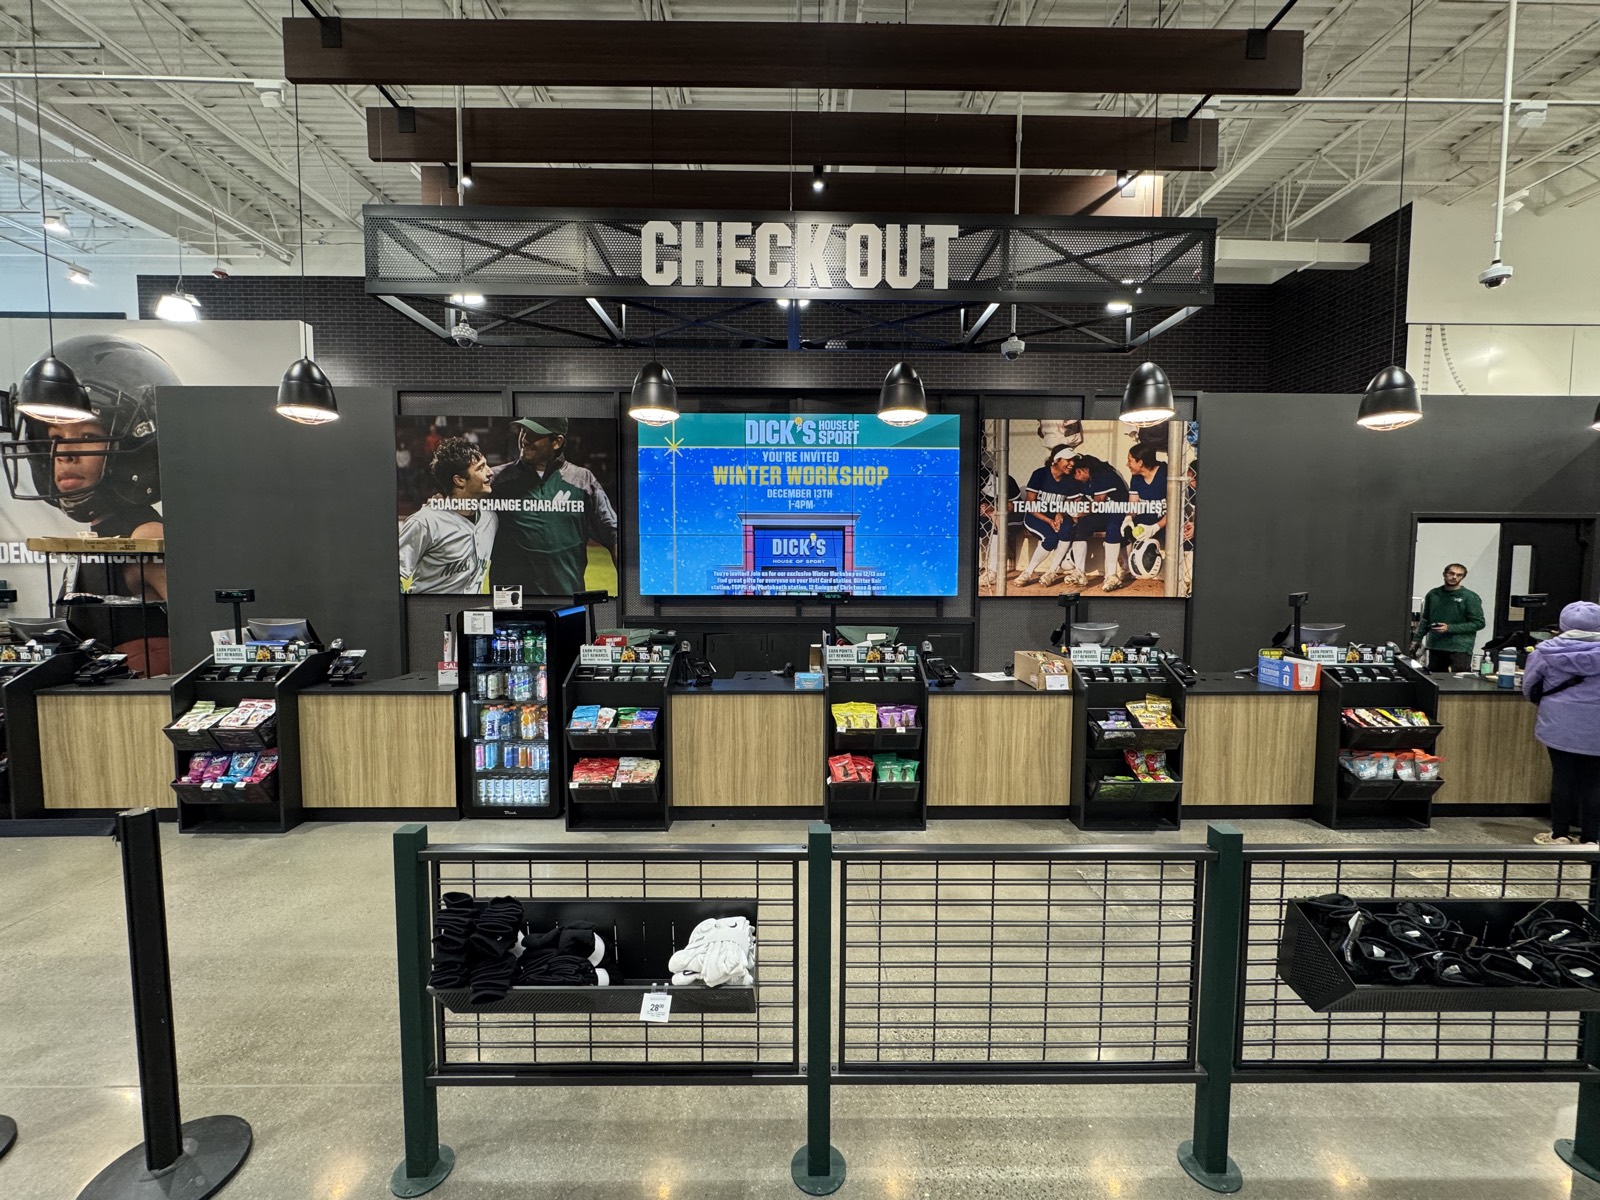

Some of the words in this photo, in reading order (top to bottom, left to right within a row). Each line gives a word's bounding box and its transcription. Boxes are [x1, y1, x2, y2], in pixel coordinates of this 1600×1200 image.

[746, 419, 816, 444] DICK'S
[819, 420, 847, 430] HOUSE
[848, 420, 859, 430] OF
[819, 431, 859, 444] SPORT
[762, 452, 797, 462] YOU'RE
[800, 452, 839, 462] INVITED
[713, 466, 782, 485] WINTER
[786, 466, 888, 486] WORKSHOP
[767, 489, 812, 498] DECEMBER
[814, 489, 832, 498] 13TH
[430, 498, 478, 511] COACHES
[480, 499, 521, 512] CHANGE
[523, 500, 584, 512] CHARACTER
[788, 501, 814, 510] 1-4PM
[1013, 501, 1048, 512] TEAMS
[1050, 501, 1089, 513] CHANGE
[1092, 501, 1163, 514] COMMUNITIES
[772, 538, 826, 555] DICK'S
